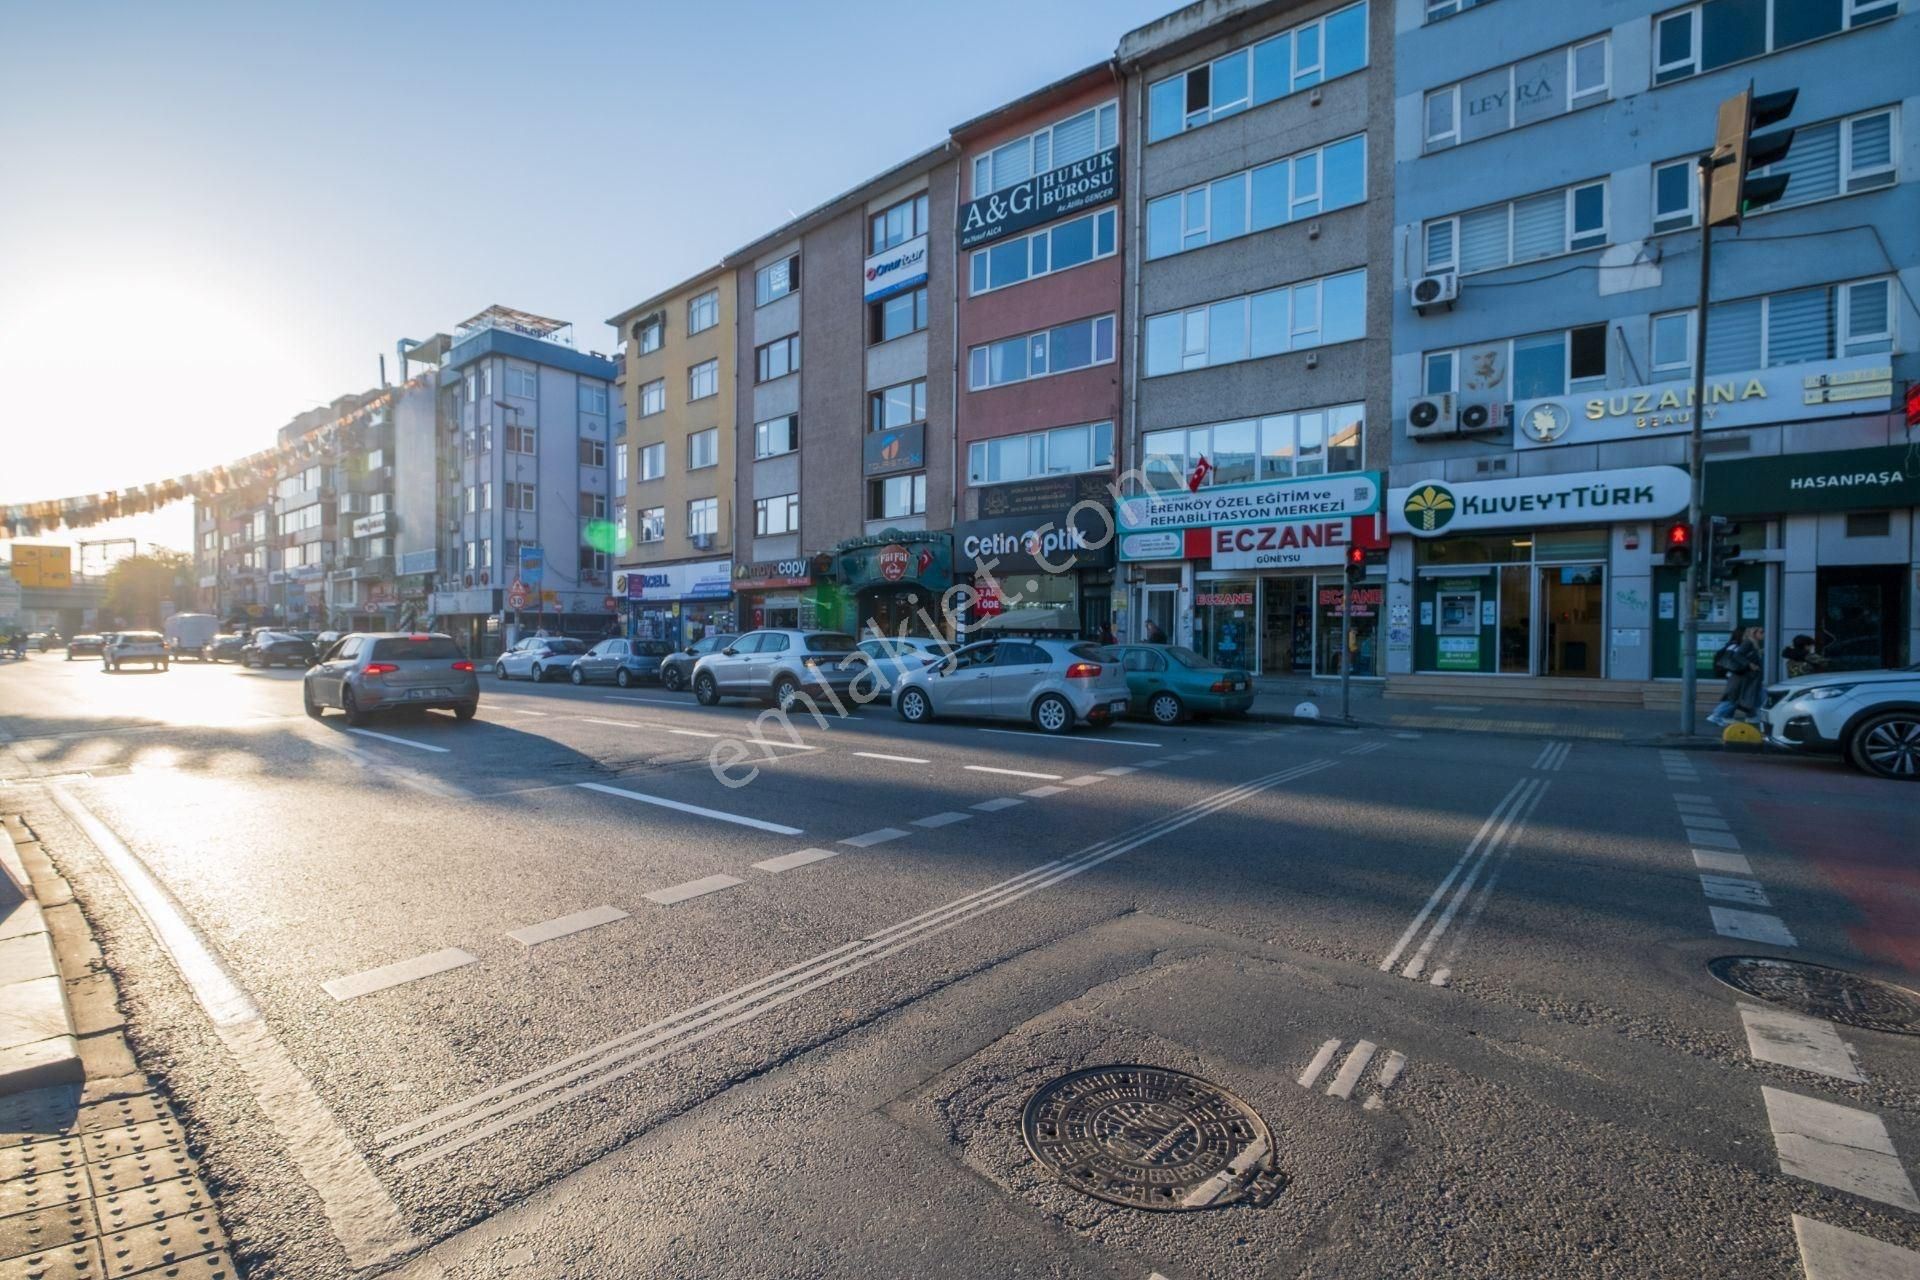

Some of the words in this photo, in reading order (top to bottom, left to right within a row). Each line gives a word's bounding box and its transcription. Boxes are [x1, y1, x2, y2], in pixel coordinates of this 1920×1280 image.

[1470, 80, 1551, 116] LEYRA
[1043, 152, 1114, 188] HUKUK
[1042, 169, 1114, 206] BÜROSU
[963, 182, 1033, 232] A&G
[1585, 377, 1768, 421] SUZANNA
[1636, 407, 1719, 429] BEAUY
[1790, 471, 1904, 489] HASANPAŞA
[1150, 499, 1213, 515] ERENKÖY
[1216, 495, 1252, 509] ÖZEL
[1256, 490, 1310, 505] EĞİTİM
[1313, 490, 1331, 500] ve
[1150, 509, 1271, 526] REHABİLİTASYON
[1274, 499, 1345, 517] MERKEZİ
[1216, 522, 1344, 553] ECZANE
[1256, 554, 1301, 564] GÜNEYSU
[1196, 591, 1253, 606] ECZANE
